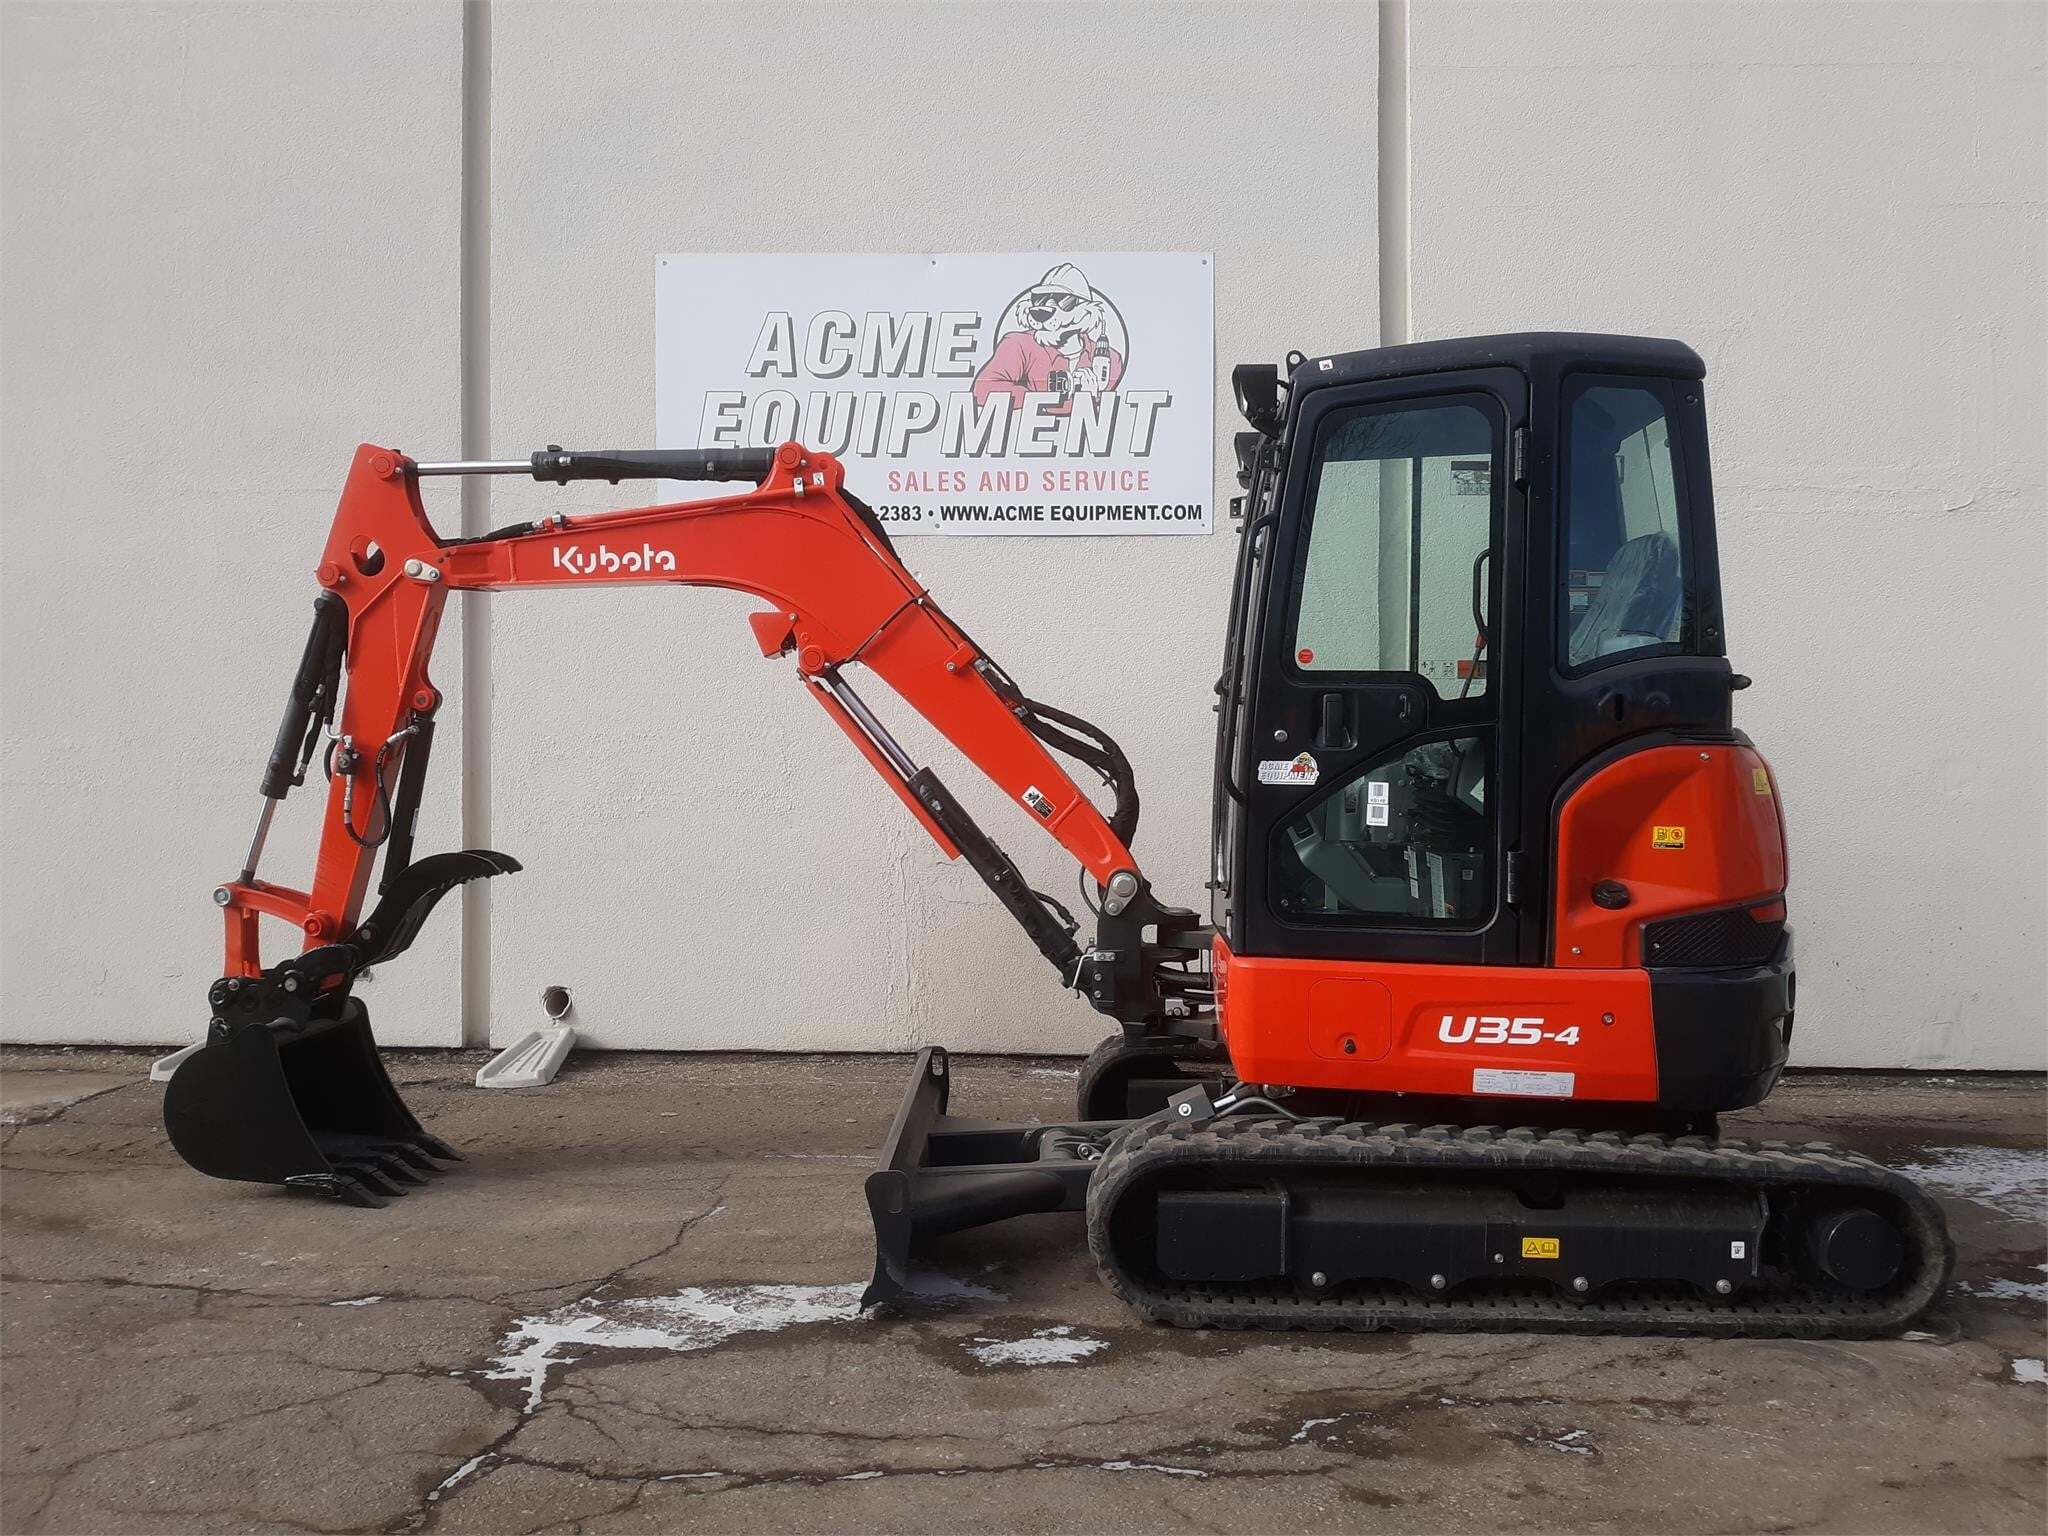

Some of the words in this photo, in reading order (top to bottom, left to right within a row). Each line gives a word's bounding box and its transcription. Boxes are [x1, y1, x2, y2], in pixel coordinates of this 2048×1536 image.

[744, 310, 982, 379] ACME
[697, 389, 1173, 457] EQUIPMENT
[888, 470, 967, 492] SALES
[978, 470, 1029, 492] AND
[1042, 470, 1149, 492] SERVICE
[940, 505, 1044, 521] WWW.ACME
[1050, 504, 1202, 522] EQUIPMENT.COM
[553, 543, 676, 574] Kubota
[1438, 1015, 1580, 1046] U35-4
